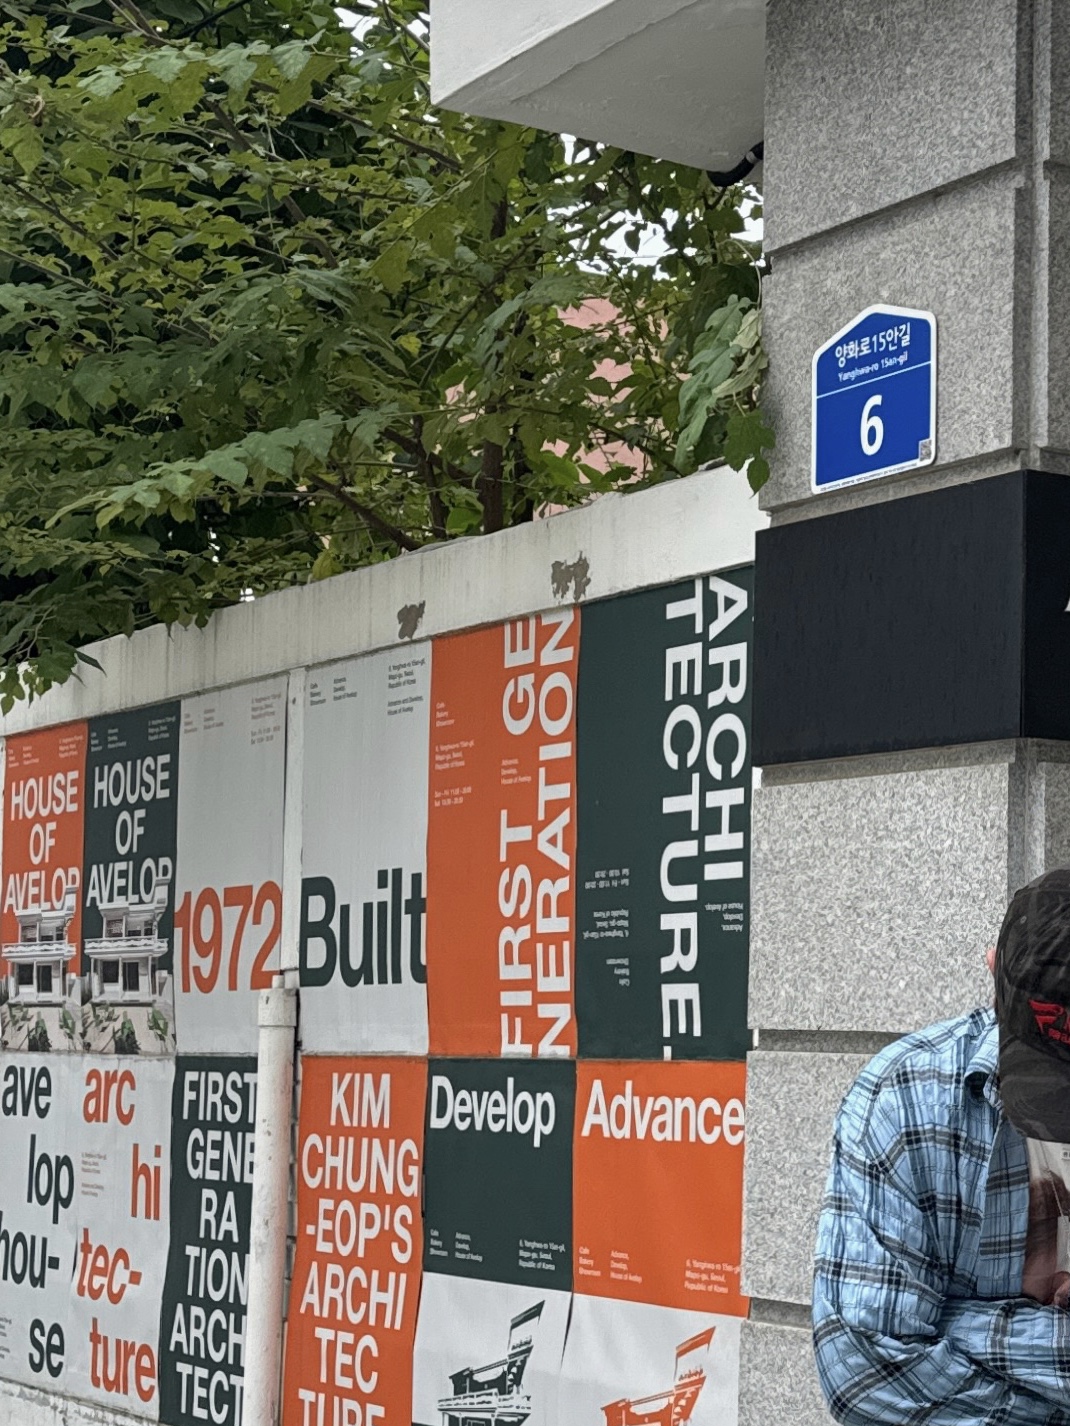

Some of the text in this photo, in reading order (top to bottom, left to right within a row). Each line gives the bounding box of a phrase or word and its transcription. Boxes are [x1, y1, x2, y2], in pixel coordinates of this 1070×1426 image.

[834, 322, 911, 368] 양화로15안길
[838, 350, 908, 382] Yanghwa-ro 15an-gil
[860, 394, 884, 456] 6
[502, 615, 536, 736] GE
[703, 575, 748, 880] ARCHI
[11, 770, 79, 821] HOUSE
[93, 753, 171, 809] HOUSE
[29, 821, 57, 865] OF
[115, 808, 147, 855] OF
[535, 607, 574, 1058] NERATION
[659, 577, 703, 1061] TECTURE.
[174, 880, 283, 994] 1972
[298, 867, 427, 987] Built
[498, 809, 533, 1058] FIRST
[2, 1065, 52, 1119] ave
[83, 1068, 136, 1126] arc
[182, 1071, 258, 1124] FIRST
[330, 1072, 391, 1129] KIM
[429, 1075, 555, 1148] Develop
[581, 1079, 745, 1146] Advance
[27, 1133, 75, 1225] lop
[131, 1143, 162, 1221] hi
[186, 1127, 255, 1184] GENE
[301, 1133, 419, 1198] CHUNG
[198, 1188, 239, 1243] RA
[305, 1199, 414, 1265] -EOP'S
[77, 1227, 142, 1305] tec-
[185, 1244, 250, 1306] TION
[299, 1261, 407, 1330] ARCHI
[28, 1318, 65, 1379] se
[89, 1317, 156, 1403] ture
[314, 1327, 379, 1393] TEC
